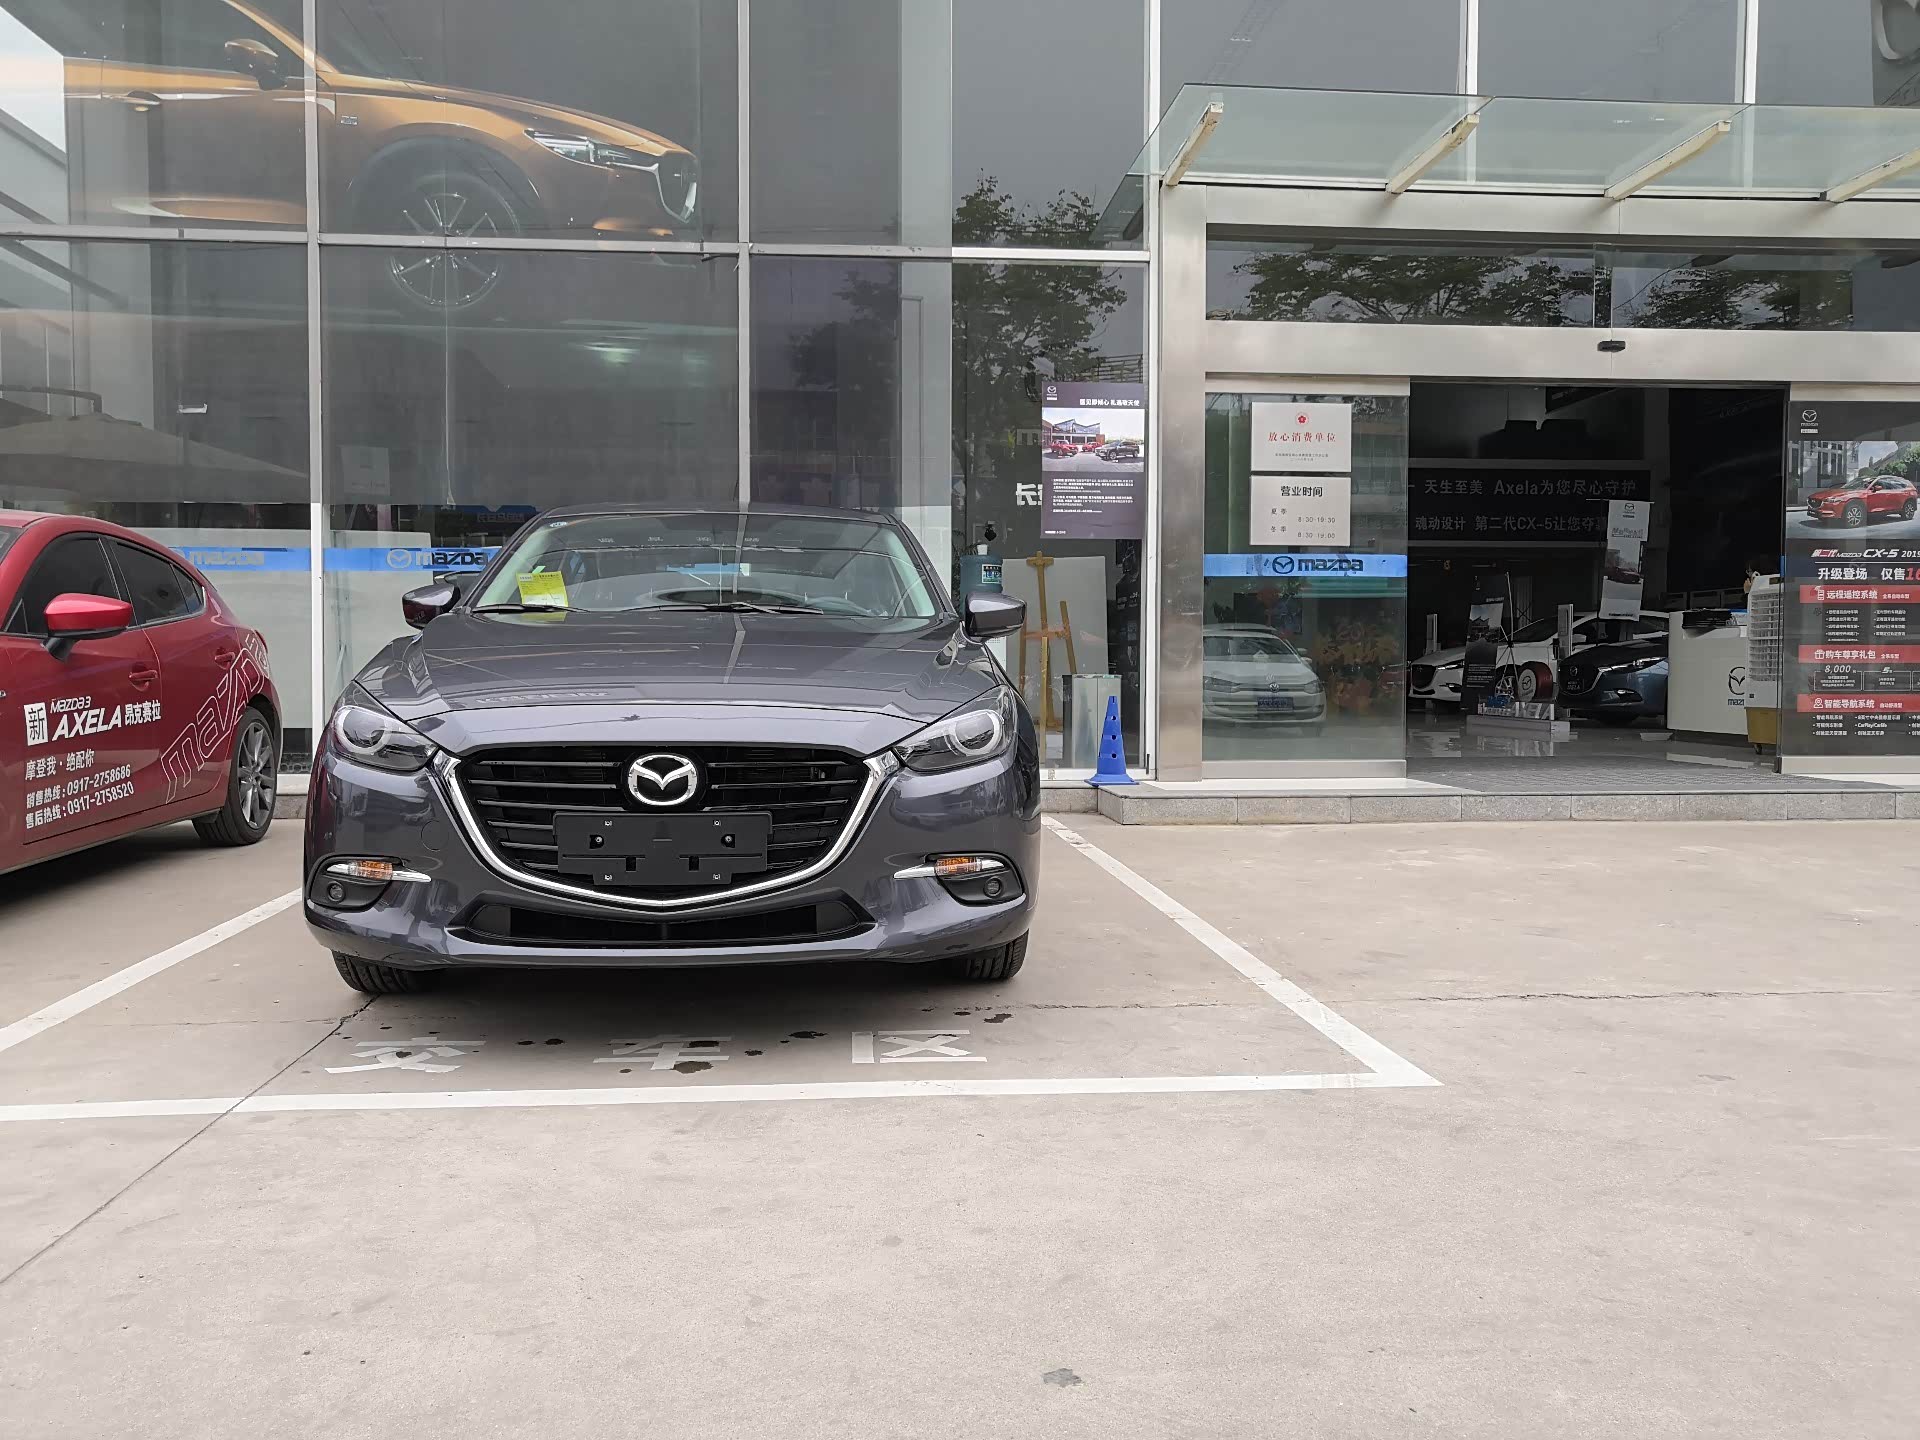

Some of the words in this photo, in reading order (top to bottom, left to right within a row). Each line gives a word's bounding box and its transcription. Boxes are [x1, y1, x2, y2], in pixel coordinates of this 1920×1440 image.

[1268, 431, 1336, 442] 放心消费单位
[1280, 485, 1323, 497] 营业时间
[1424, 479, 1483, 495] 天生至美
[1016, 483, 1042, 506] 长
[189, 550, 264, 566] mazda
[415, 551, 489, 567] mazda
[1863, 548, 1900, 558] CX-5
[1297, 558, 1364, 572] mazda
[1817, 567, 1868, 580] 升级登场
[1826, 590, 1878, 600] 远程遥控系统
[1825, 649, 1876, 659] 购车尊享礼包
[1824, 664, 1852, 674] 8,000
[1824, 699, 1875, 709] 智能导航系统
[27, 706, 46, 742] 新
[52, 705, 122, 742] AXELA
[124, 699, 162, 726] 昂克赛拉
